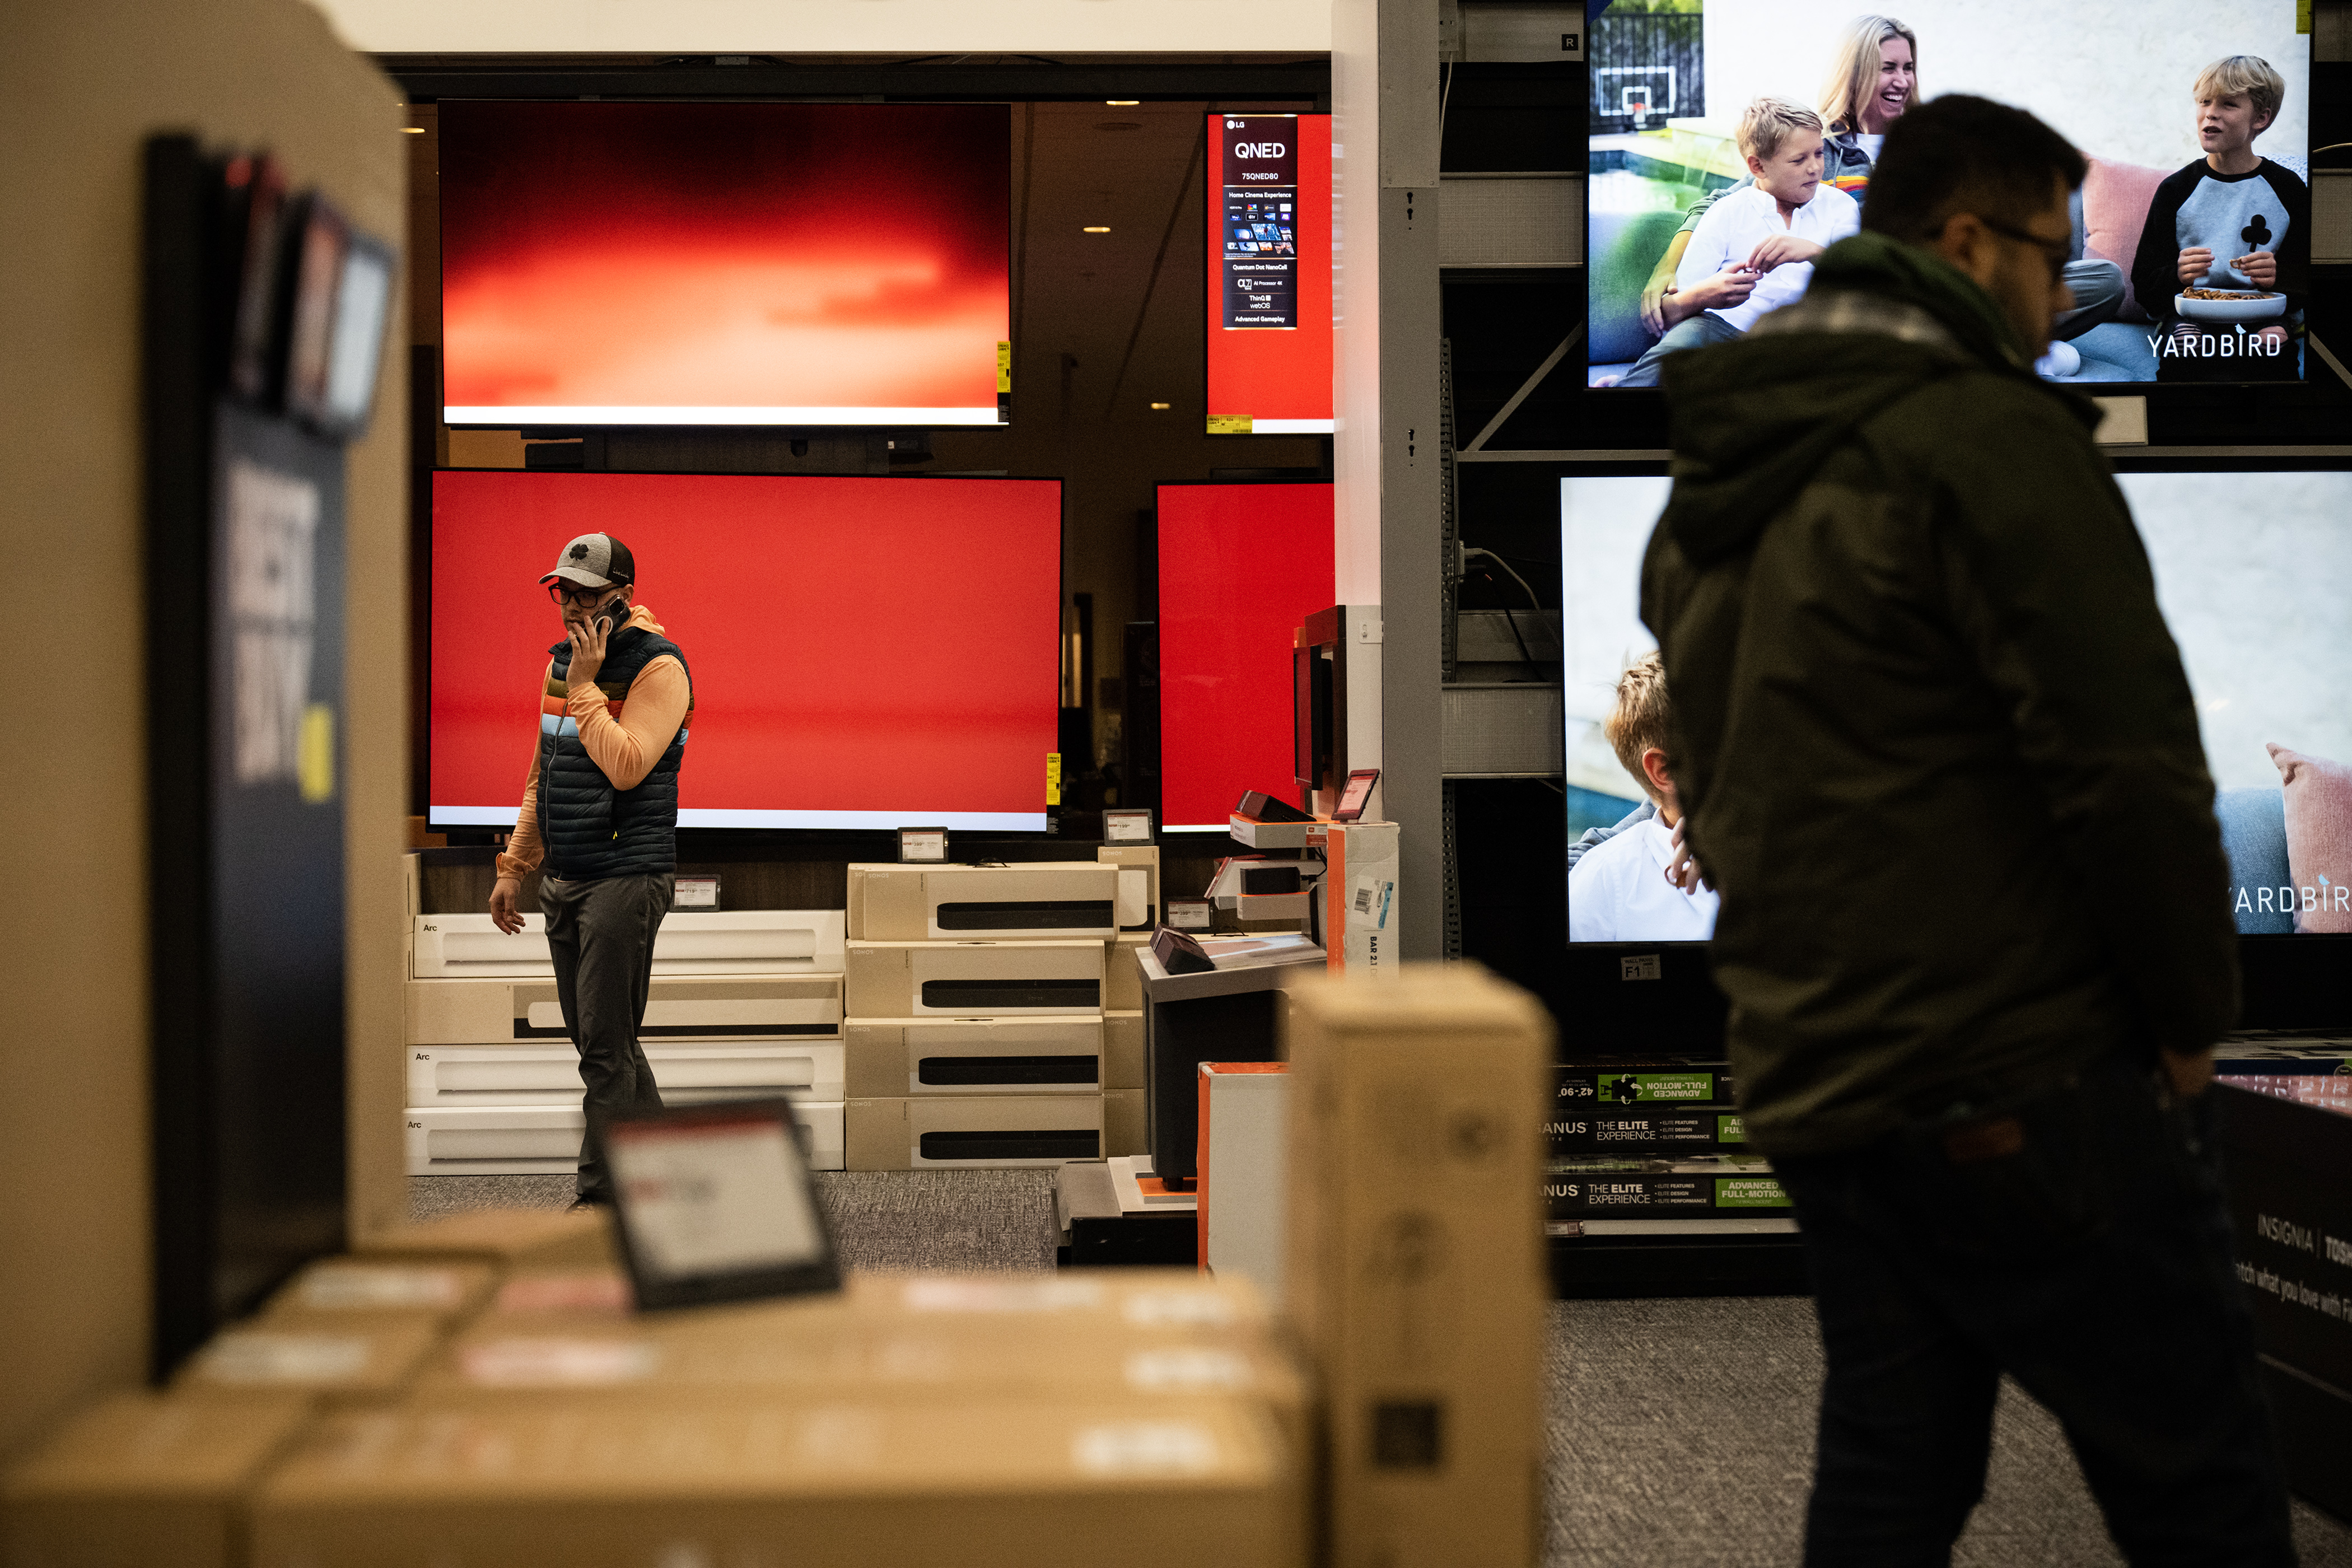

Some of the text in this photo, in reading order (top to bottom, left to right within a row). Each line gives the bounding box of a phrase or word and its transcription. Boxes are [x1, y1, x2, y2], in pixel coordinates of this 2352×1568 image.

[1566, 38, 1574, 47] R
[1235, 142, 1286, 158] QNED
[2147, 334, 2280, 357] YARDBIRD
[2229, 886, 2350, 913] ARDBIR
[1626, 966, 1640, 977] F1
[1538, 1122, 1587, 1134] ANUS
[1596, 1121, 1649, 1130] THE ELITE
[1597, 1131, 1656, 1141] EXPERIENCE
[1588, 1184, 1643, 1193] THE ELITE
[1722, 1189, 1786, 1198] FULL-MOTION
[1589, 1194, 1651, 1204] EXPERIENCE
[2257, 1212, 2315, 1254] INSIGNIA
[2256, 1267, 2280, 1294] what
[2280, 1279, 2299, 1303] you
[2320, 1291, 2341, 1319] with
